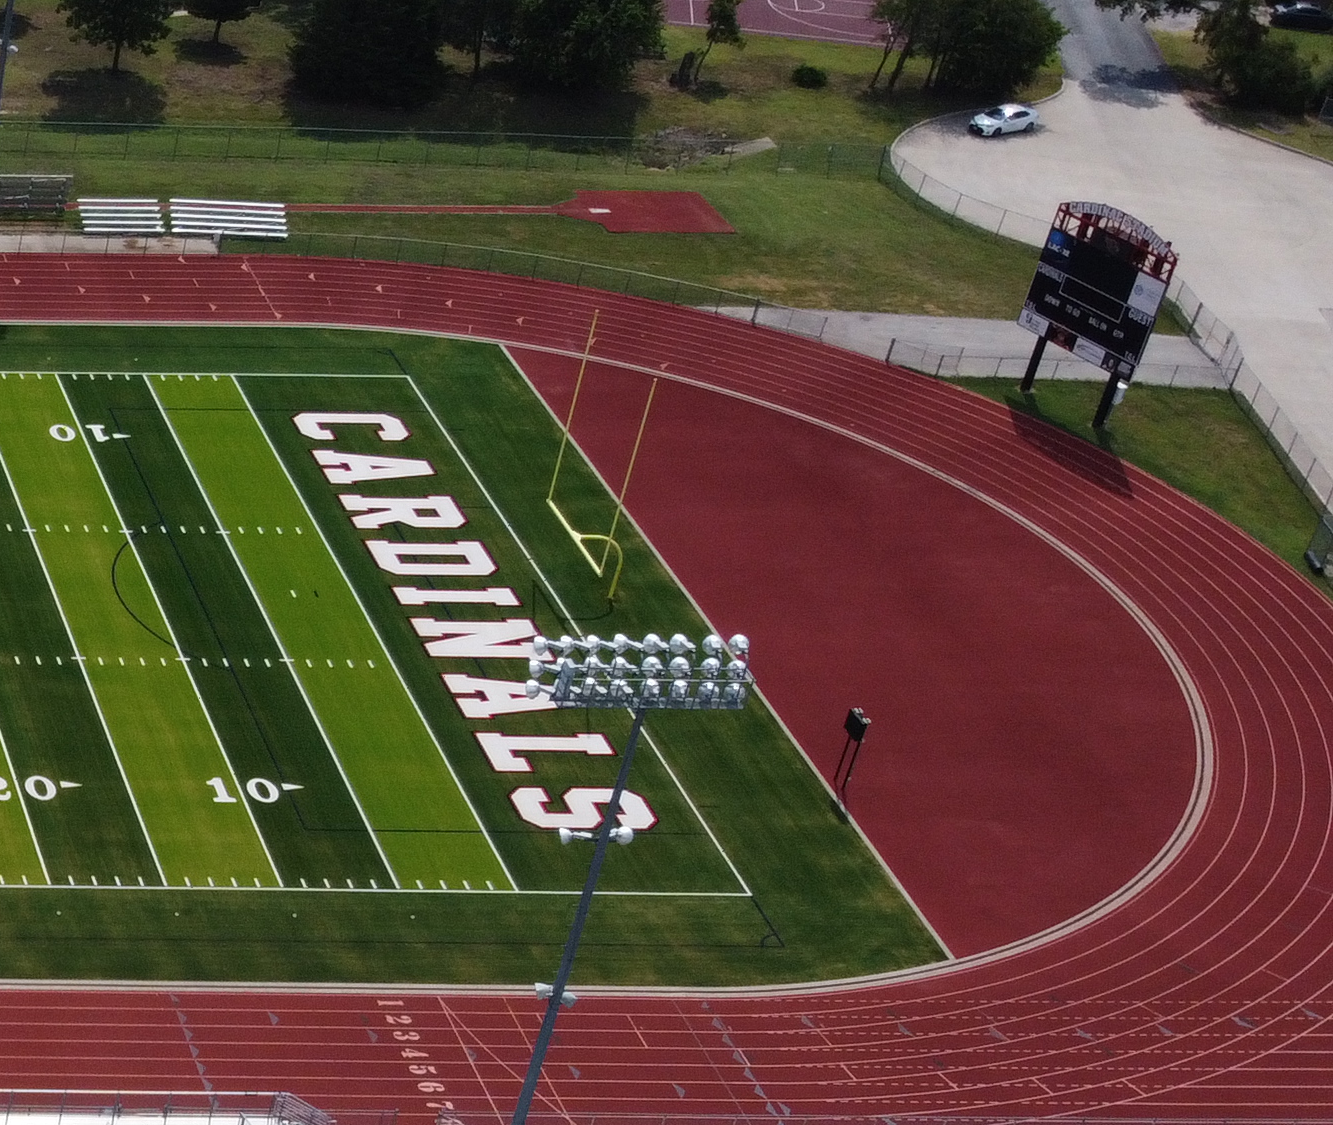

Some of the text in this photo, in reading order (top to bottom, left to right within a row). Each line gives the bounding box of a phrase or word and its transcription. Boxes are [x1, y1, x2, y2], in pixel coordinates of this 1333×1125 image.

[1123, 214, 1170, 255] STADIUM
[1128, 308, 1155, 327] GUEST
[48, 424, 110, 442] 10
[291, 412, 659, 830] CARDINALS
[206, 776, 280, 803] 10
[385, 1014, 413, 1024] 2
[393, 1031, 420, 1040] 3
[401, 1048, 430, 1058] 4
[408, 1065, 437, 1074] 5
[417, 1082, 445, 1093] 6
[426, 1101, 454, 1110] 7
